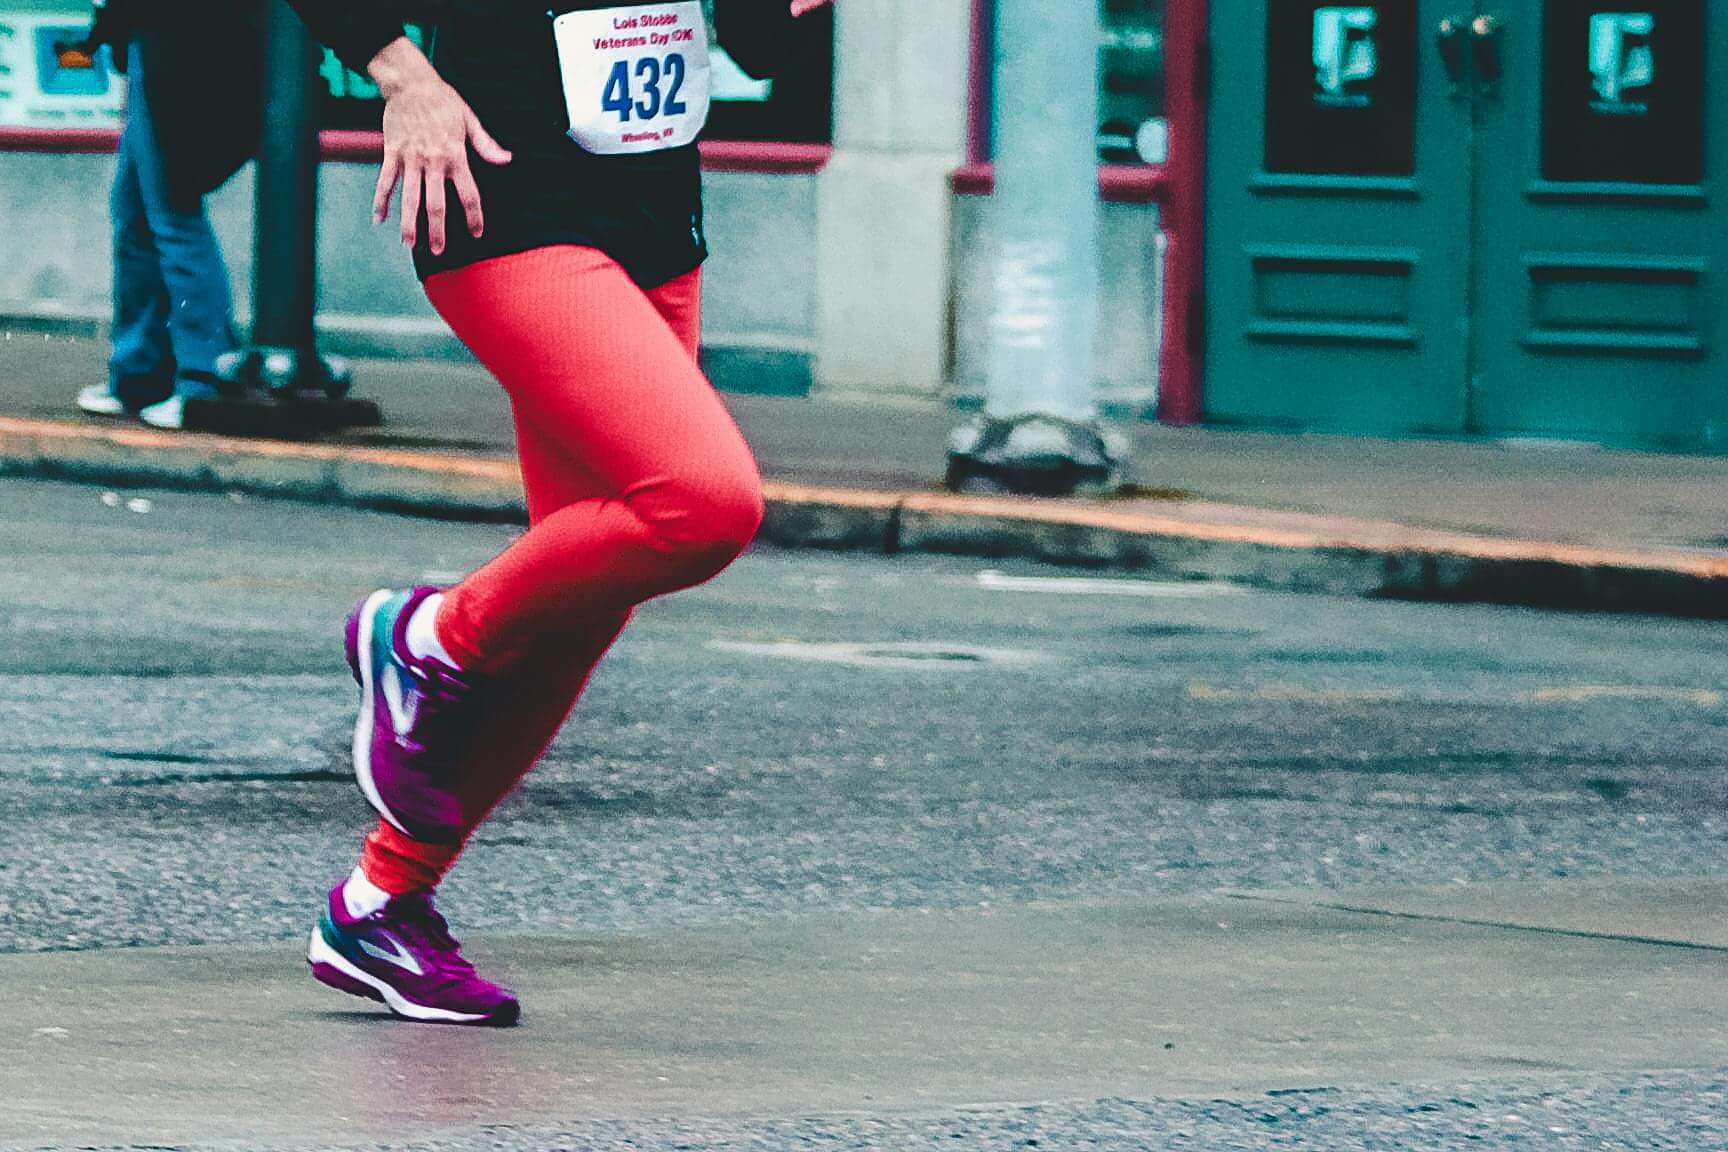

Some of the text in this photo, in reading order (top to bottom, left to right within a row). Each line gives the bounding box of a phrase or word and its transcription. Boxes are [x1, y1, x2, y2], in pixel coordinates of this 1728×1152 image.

[593, 36, 647, 50] Veterans
[650, 31, 670, 45] Day
[601, 53, 687, 122] 432
